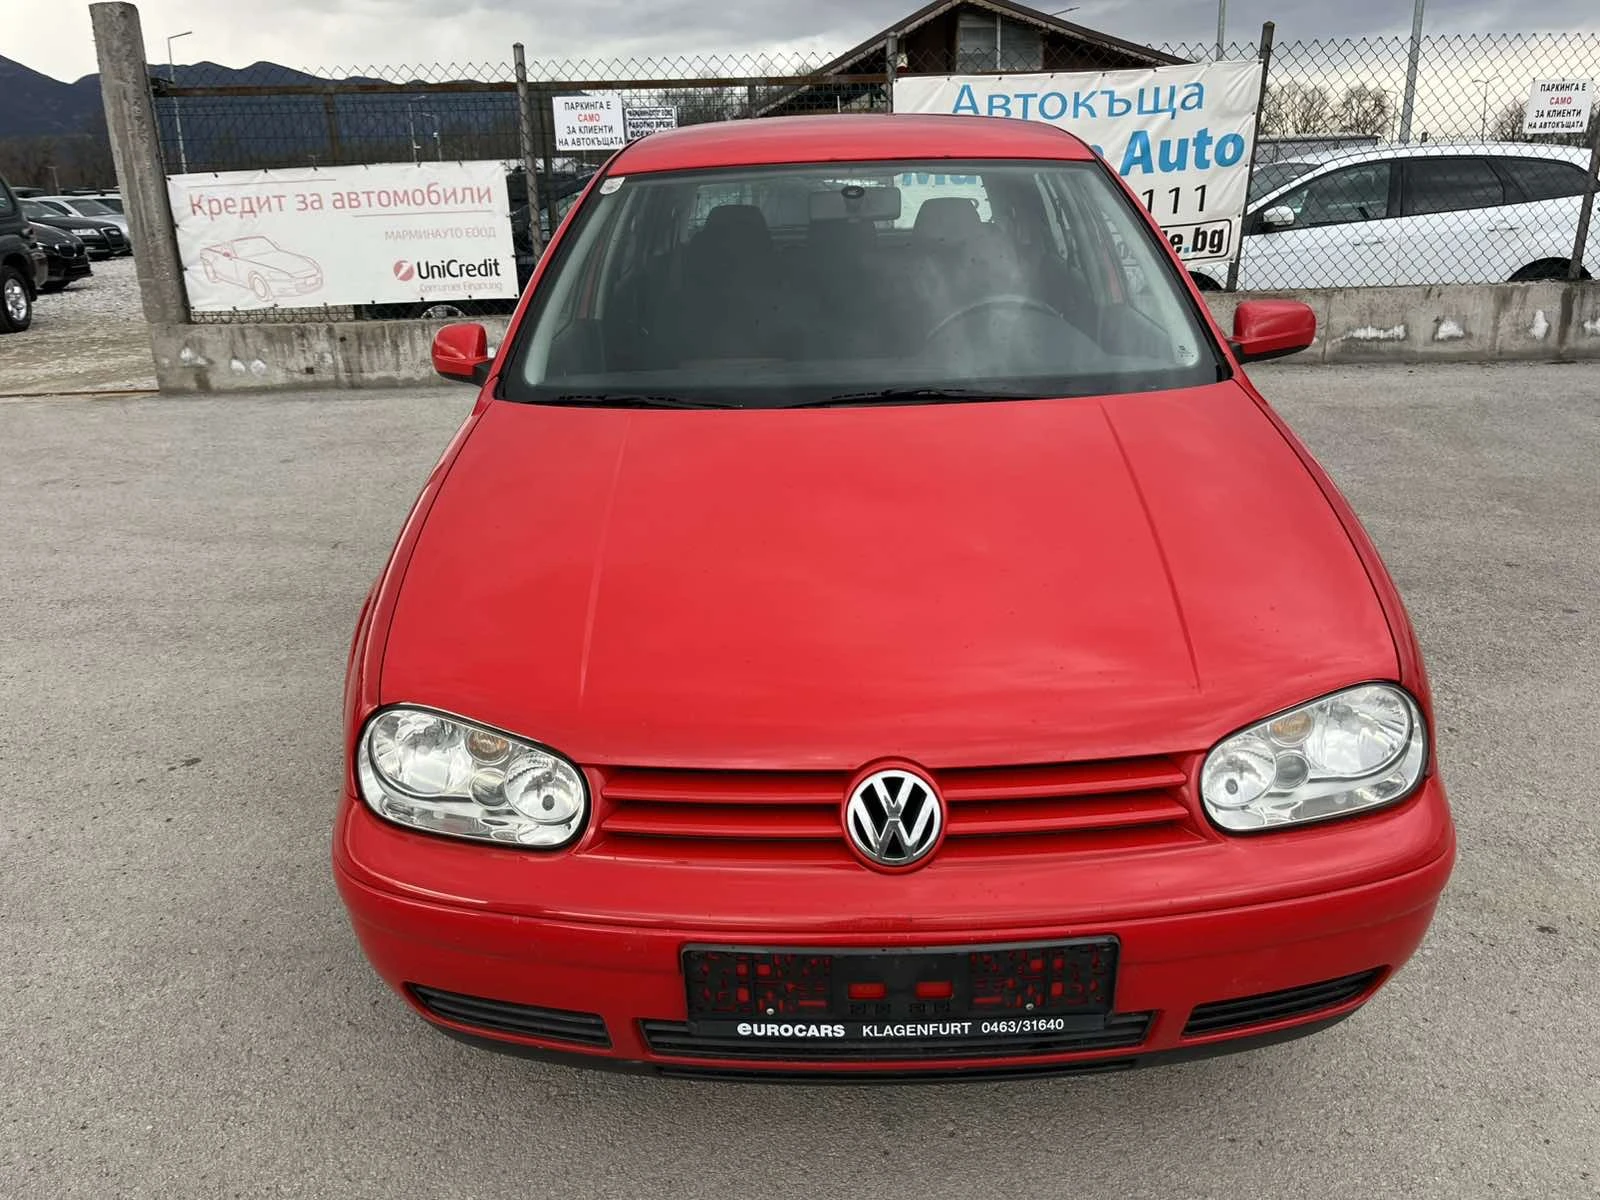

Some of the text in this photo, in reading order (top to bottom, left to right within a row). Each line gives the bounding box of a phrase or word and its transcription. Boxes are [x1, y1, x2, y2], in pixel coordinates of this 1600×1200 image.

[1540, 82, 1587, 92] ПАРКИНГА Е
[564, 100, 612, 111] ПАРКИНГА Е
[952, 81, 1205, 120] Автокъща
[1550, 96, 1572, 105] САМО
[577, 113, 600, 122] САМО
[1535, 109, 1582, 118] ЗА КЛИЕНТИ
[566, 125, 614, 135] ЗА КЛИЕНТИ
[1539, 121, 1584, 129] АВТОКЪЩАТА
[559, 137, 624, 147] НА АВТОКЪЩАТА
[1119, 127, 1245, 176] Auto
[189, 182, 493, 220] Кредит за автомобили
[384, 226, 497, 241] МАРМИНАУТО ЕООД
[417, 258, 501, 280] UniCredit
[862, 1022, 972, 1037] KLAGENFURT
[981, 1018, 1065, 1034] 0463/31640
